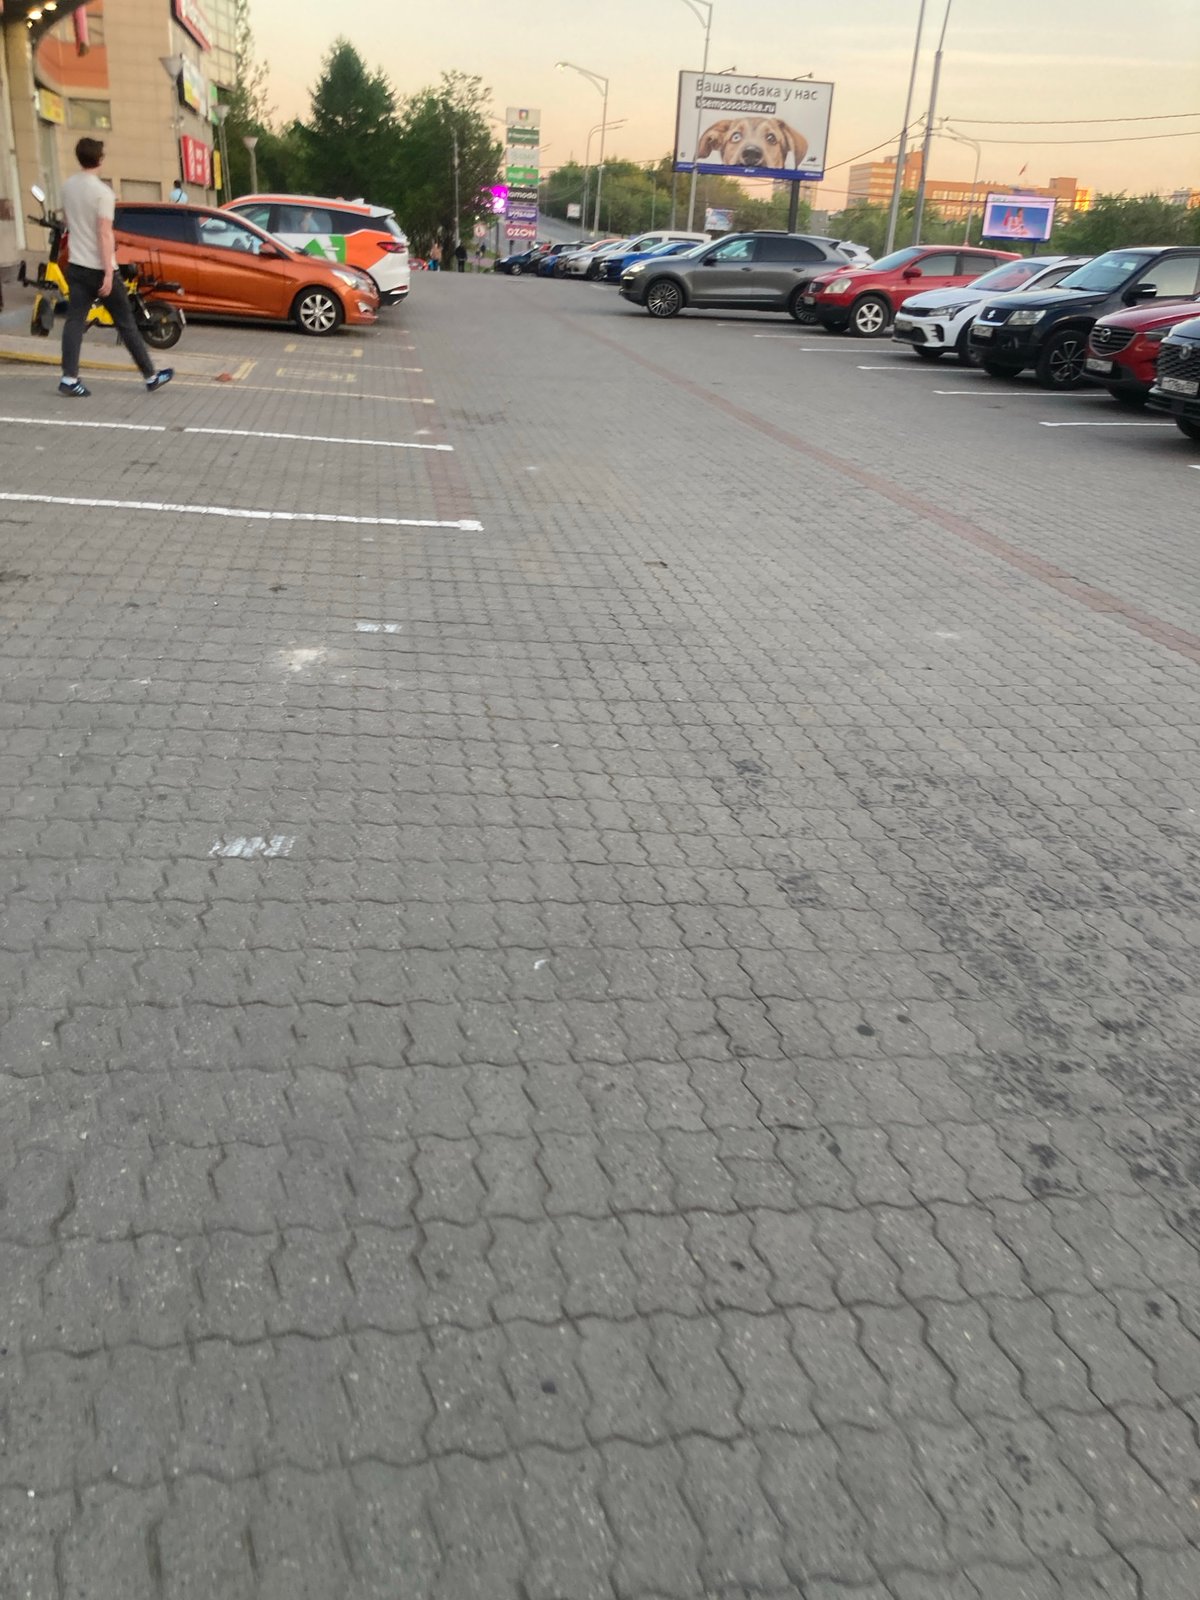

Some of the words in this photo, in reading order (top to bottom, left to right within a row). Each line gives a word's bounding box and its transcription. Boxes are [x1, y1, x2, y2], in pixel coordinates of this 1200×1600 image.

[696, 79, 731, 94] Ваша
[734, 83, 781, 97] собака
[784, 88, 792, 101] у
[795, 89, 818, 101] нас
[507, 228, 536, 237] OZON
